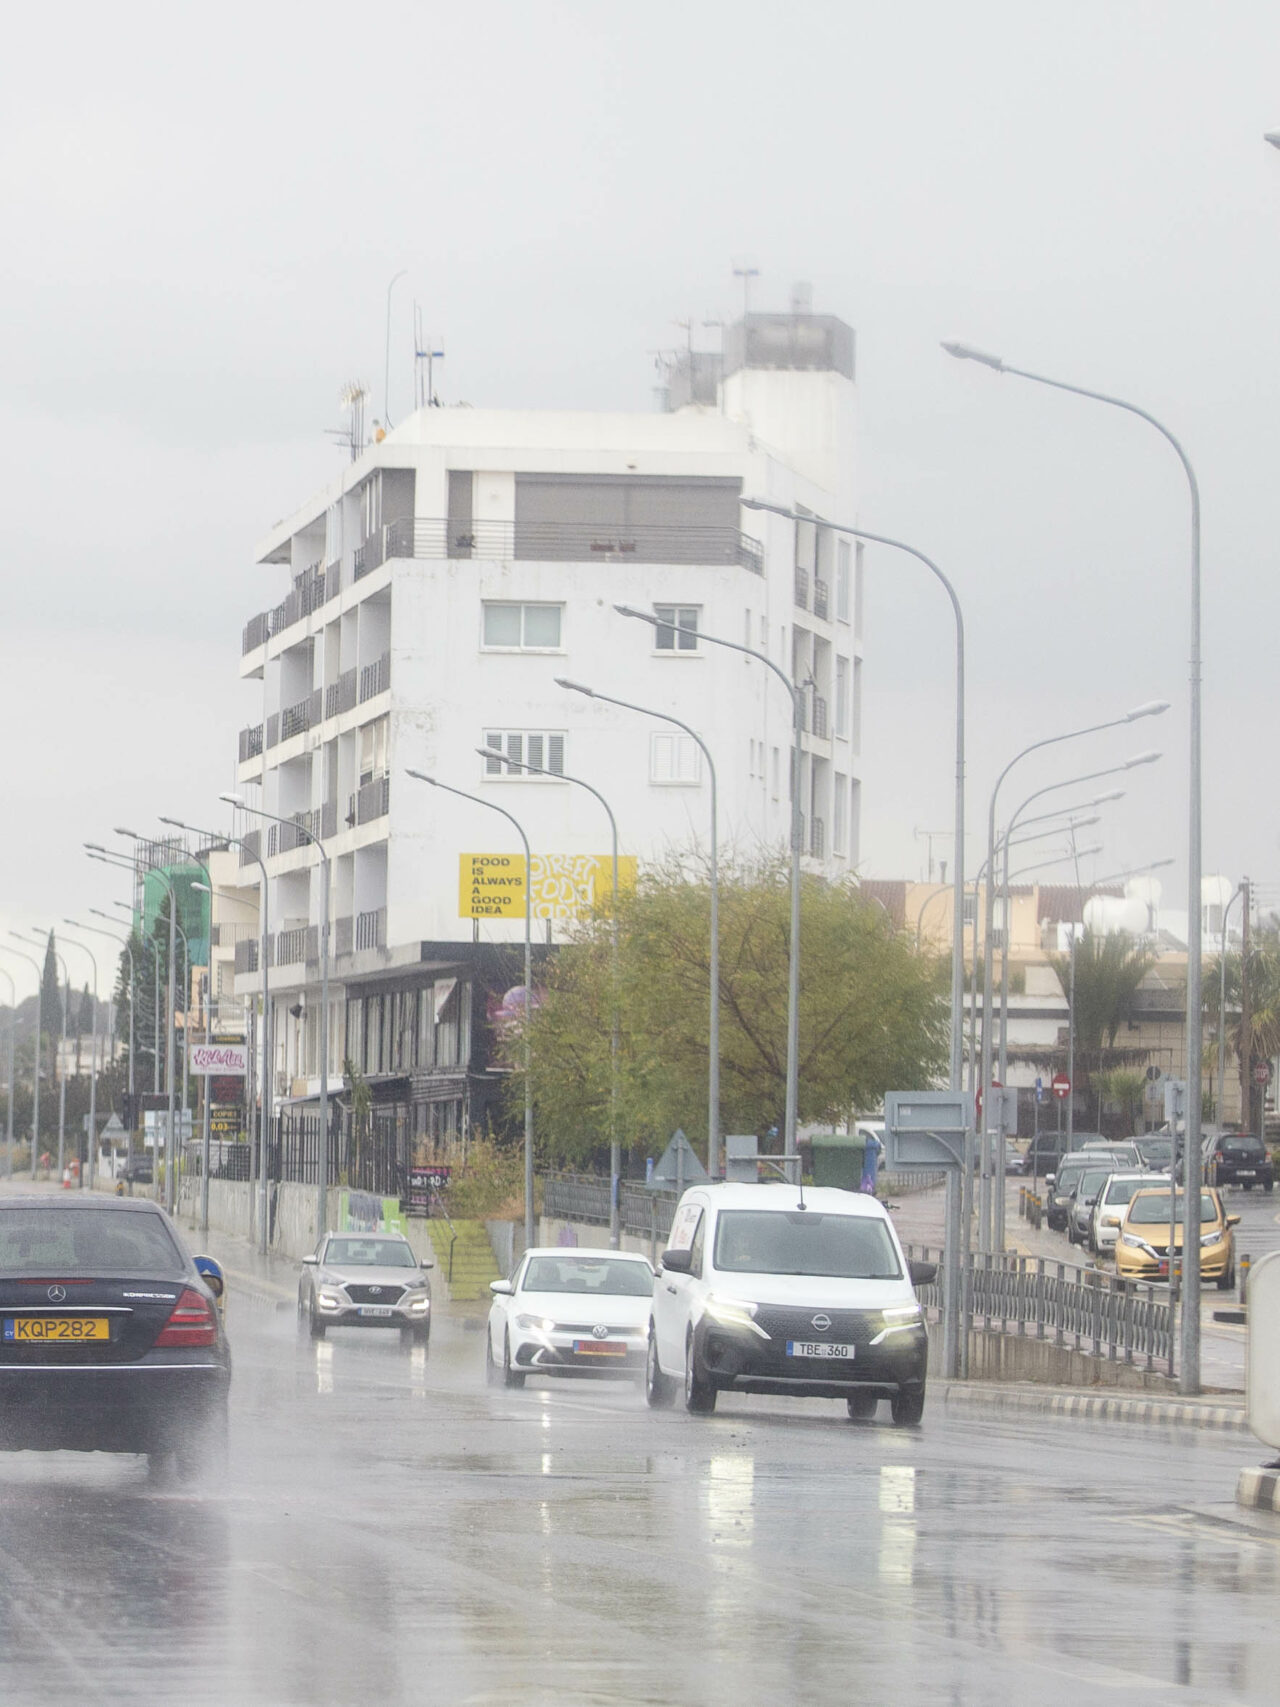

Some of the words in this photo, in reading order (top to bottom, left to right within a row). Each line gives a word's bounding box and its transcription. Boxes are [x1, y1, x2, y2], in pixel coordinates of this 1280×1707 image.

[472, 857, 510, 866] FOOD
[472, 867, 484, 876] IS
[524, 855, 600, 881] STREET
[472, 877, 522, 886] ALWAYS
[472, 887, 480, 895] A
[472, 896, 511, 905] GOOD
[472, 906, 502, 914] IDEA
[17, 1321, 97, 1338] KQP282
[800, 1343, 822, 1356] TBE
[827, 1345, 849, 1357] 360
